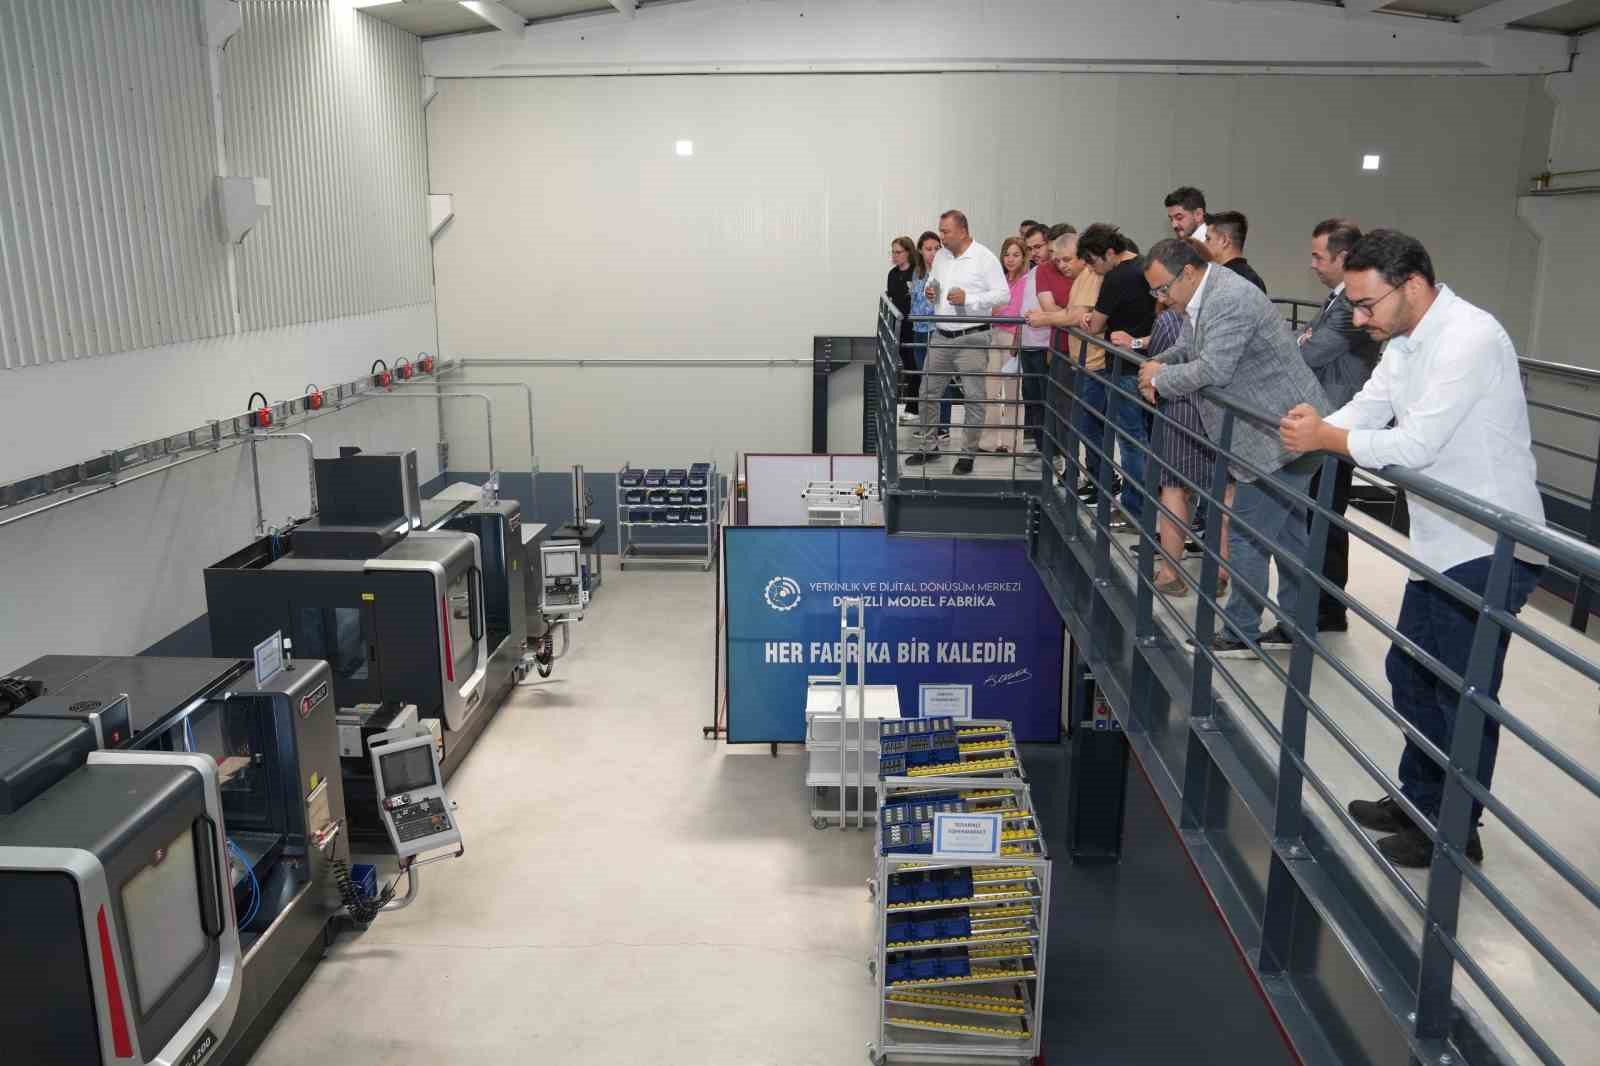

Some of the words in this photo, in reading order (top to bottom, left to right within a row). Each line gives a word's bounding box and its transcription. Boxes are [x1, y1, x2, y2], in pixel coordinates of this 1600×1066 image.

[863, 582, 877, 592] VE
[879, 580, 918, 592] DİJİTAL
[977, 580, 1022, 593] MERKEZİ
[833, 594, 883, 607] DZLİ
[887, 597, 936, 608] MODEL
[939, 594, 996, 608] FABRİKA
[765, 642, 803, 664] HER
[810, 642, 891, 664] FABRKA
[898, 637, 930, 664] BİR
[936, 637, 1016, 664] KALEDİR
